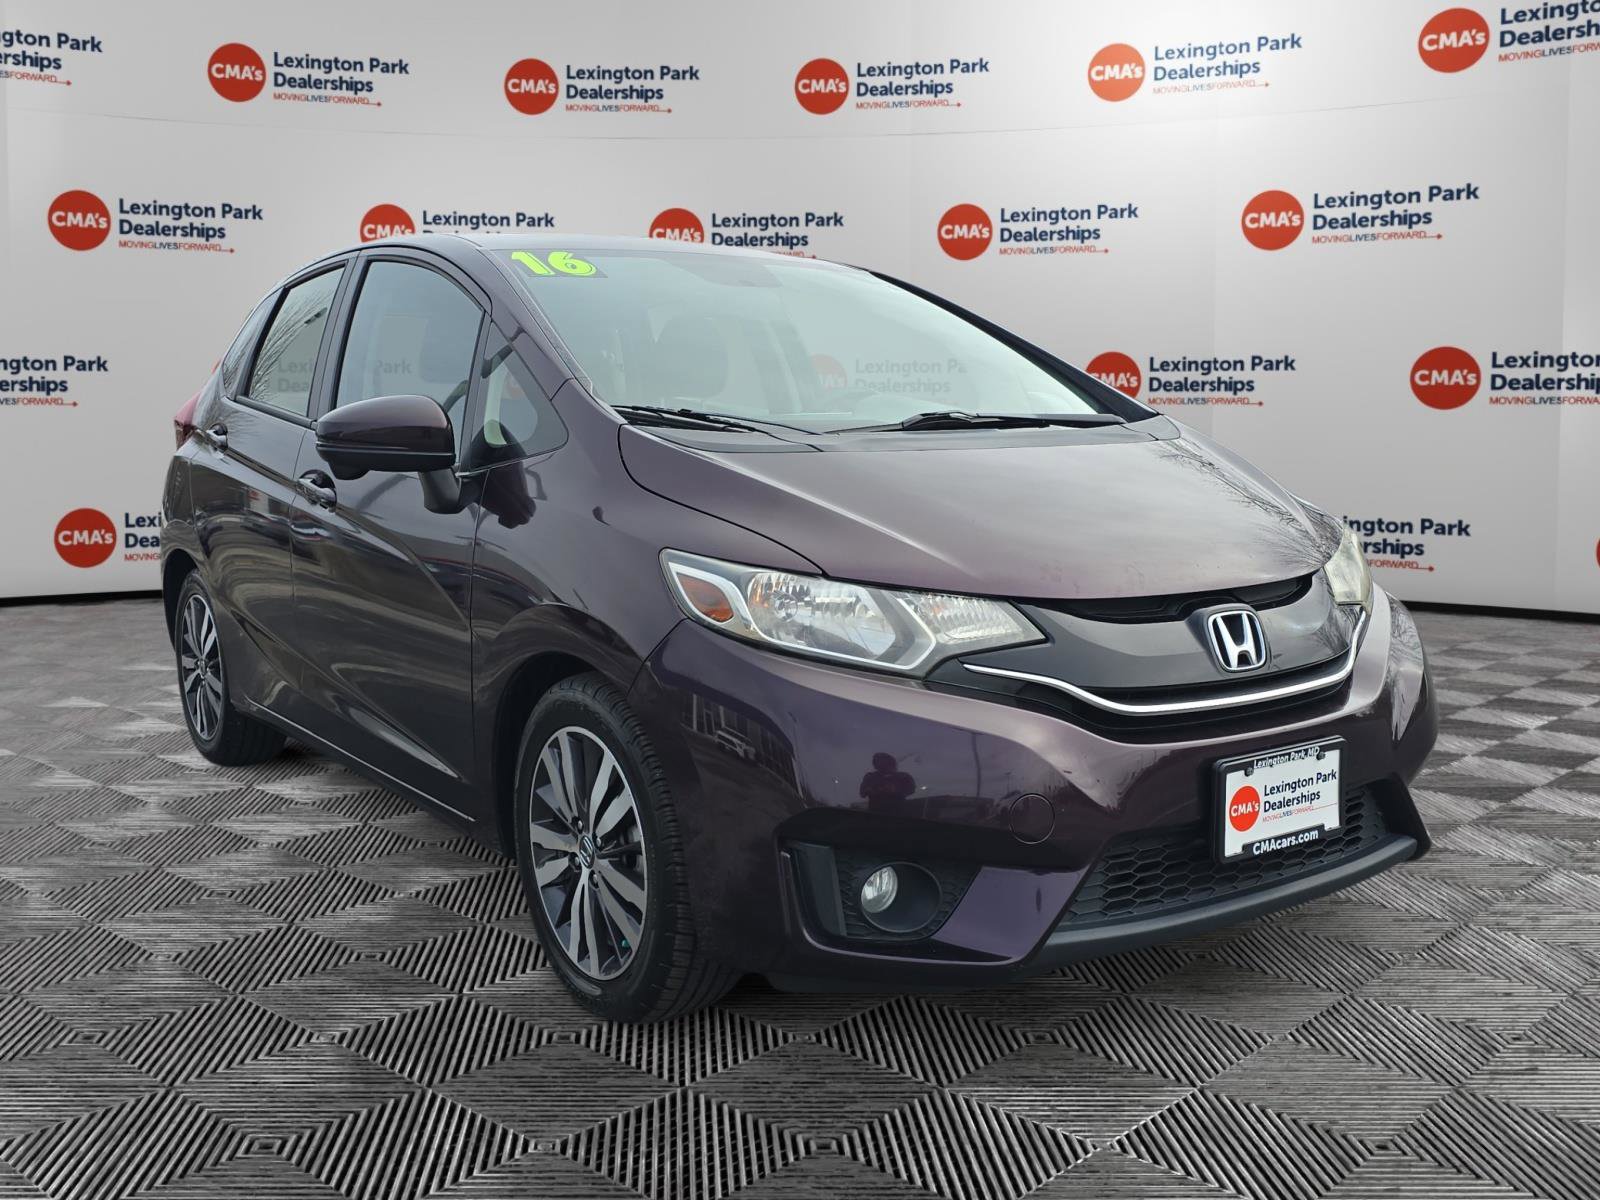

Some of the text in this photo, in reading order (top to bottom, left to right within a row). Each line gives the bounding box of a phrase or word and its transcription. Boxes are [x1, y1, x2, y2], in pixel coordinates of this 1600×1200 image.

[0, 29, 103, 53] gton Park
[1154, 33, 1302, 61] Lexington Park
[1422, 29, 1486, 51] CMA's
[0, 50, 62, 72] rships
[273, 52, 409, 75] Lexington Park
[857, 58, 989, 80] Lexington Park
[1154, 59, 1260, 81] Dealerships
[211, 63, 264, 82] CMA's
[566, 65, 700, 84] Lexington Park
[1090, 63, 1143, 81] CMA's
[273, 72, 374, 95] Dealerships
[507, 78, 556, 94] CMA's
[798, 78, 847, 94] CMA's
[856, 80, 953, 98] Dealerships
[566, 85, 664, 102] Dealerships
[1314, 183, 1479, 210] Lexington Park
[119, 198, 263, 220] Lexington Park
[1000, 203, 1138, 225] Lexington Park
[51, 210, 108, 229] CMA's
[423, 210, 554, 230] Lexington Park
[712, 212, 844, 231] Lexington Park
[1245, 210, 1301, 229] CMA's
[1312, 209, 1432, 231] Dealerships
[119, 219, 226, 242] Dealerships
[940, 224, 990, 240] CMA's
[1000, 225, 1100, 243] Dealerships
[712, 232, 808, 250] Dealerships
[511, 251, 597, 276] 16
[63, 355, 108, 372] Park
[1150, 355, 1296, 375] Lexington Park
[1149, 377, 1255, 395] Dealerships
[1414, 369, 1477, 386] CMA's
[1420, 518, 1471, 537] Park
[58, 529, 114, 546] CMA's
[1360, 538, 1424, 559] rships
[1253, 755, 1289, 769] Lexington
[1264, 769, 1337, 797] Lexington Park
[1230, 801, 1260, 817] CMA's
[1263, 789, 1321, 813] Dealerships
[1252, 830, 1319, 855] CMAcars.com
